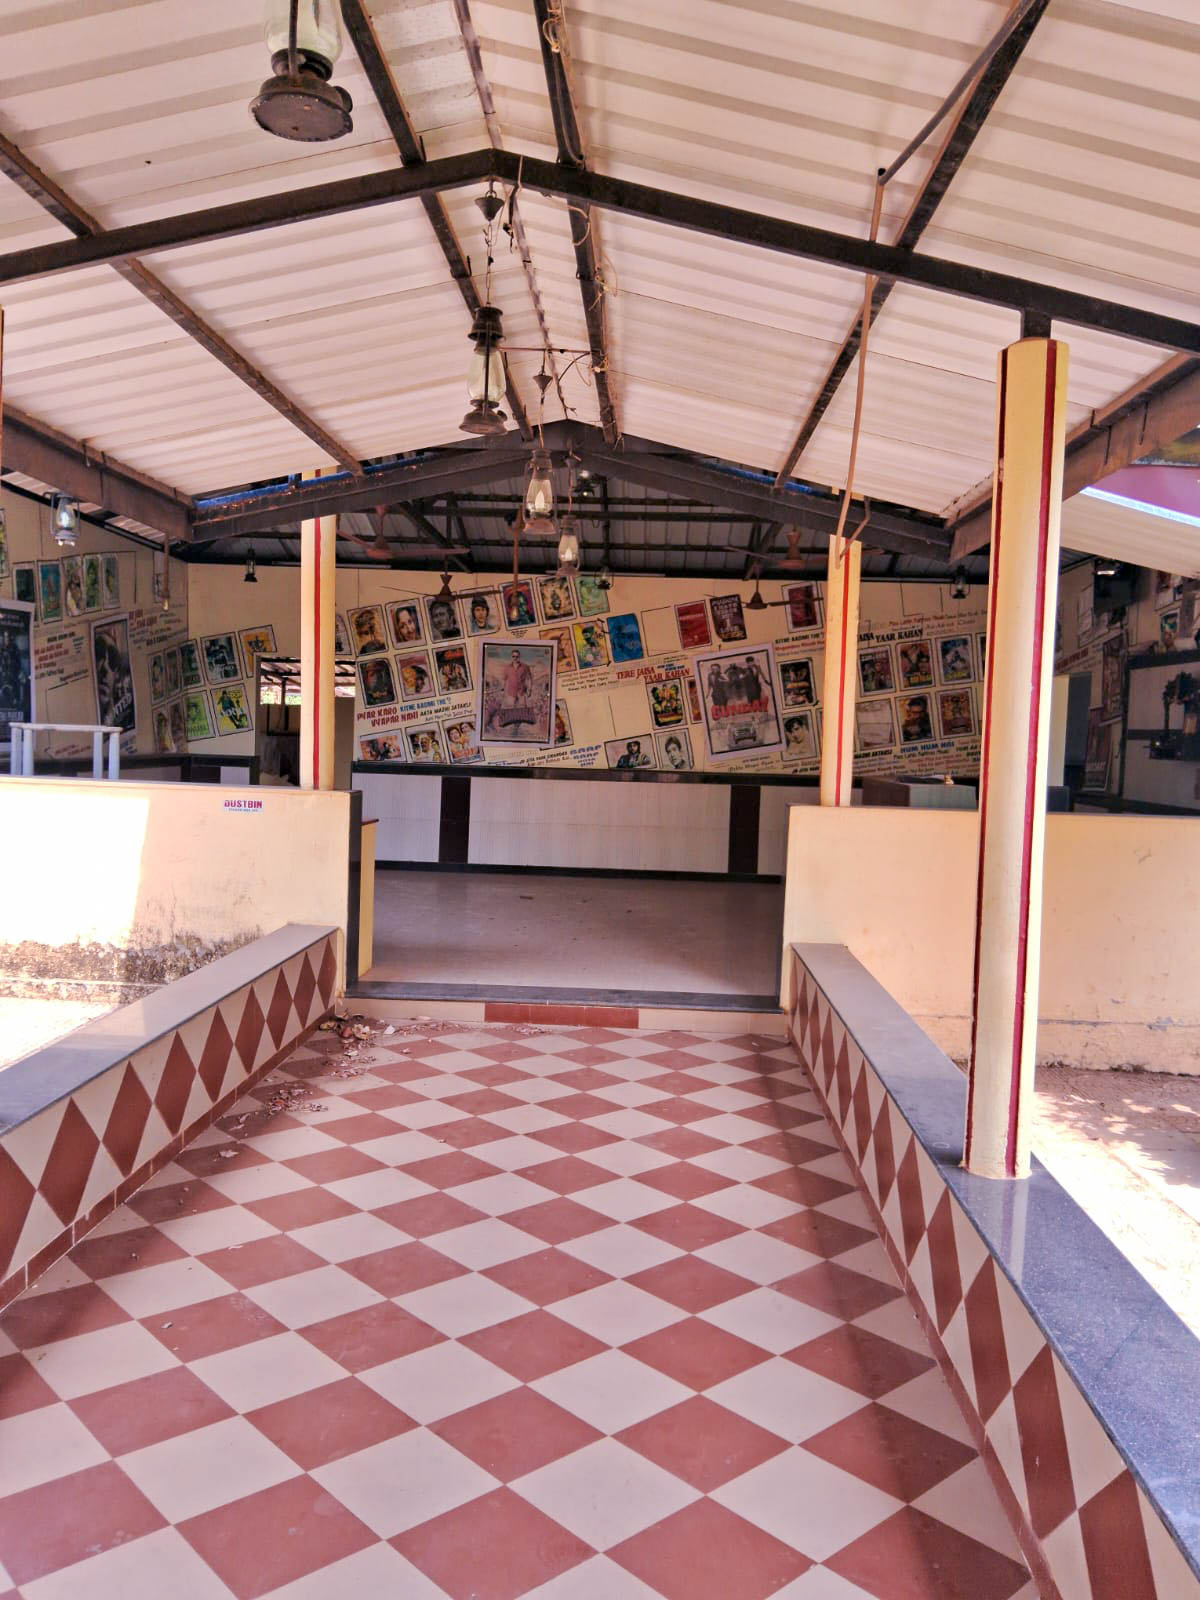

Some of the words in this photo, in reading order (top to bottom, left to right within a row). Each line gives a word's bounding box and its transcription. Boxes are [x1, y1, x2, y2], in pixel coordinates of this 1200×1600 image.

[875, 633, 896, 642] YAAR
[616, 670, 636, 680] TERE
[636, 667, 656, 679] JAISA
[643, 672, 664, 682] YAAR
[664, 668, 690, 679] KAHAN
[357, 711, 376, 720] PYAR
[378, 707, 398, 716] KARO
[371, 716, 399, 727] VYAPAR
[224, 799, 263, 809] DUSTBIN
